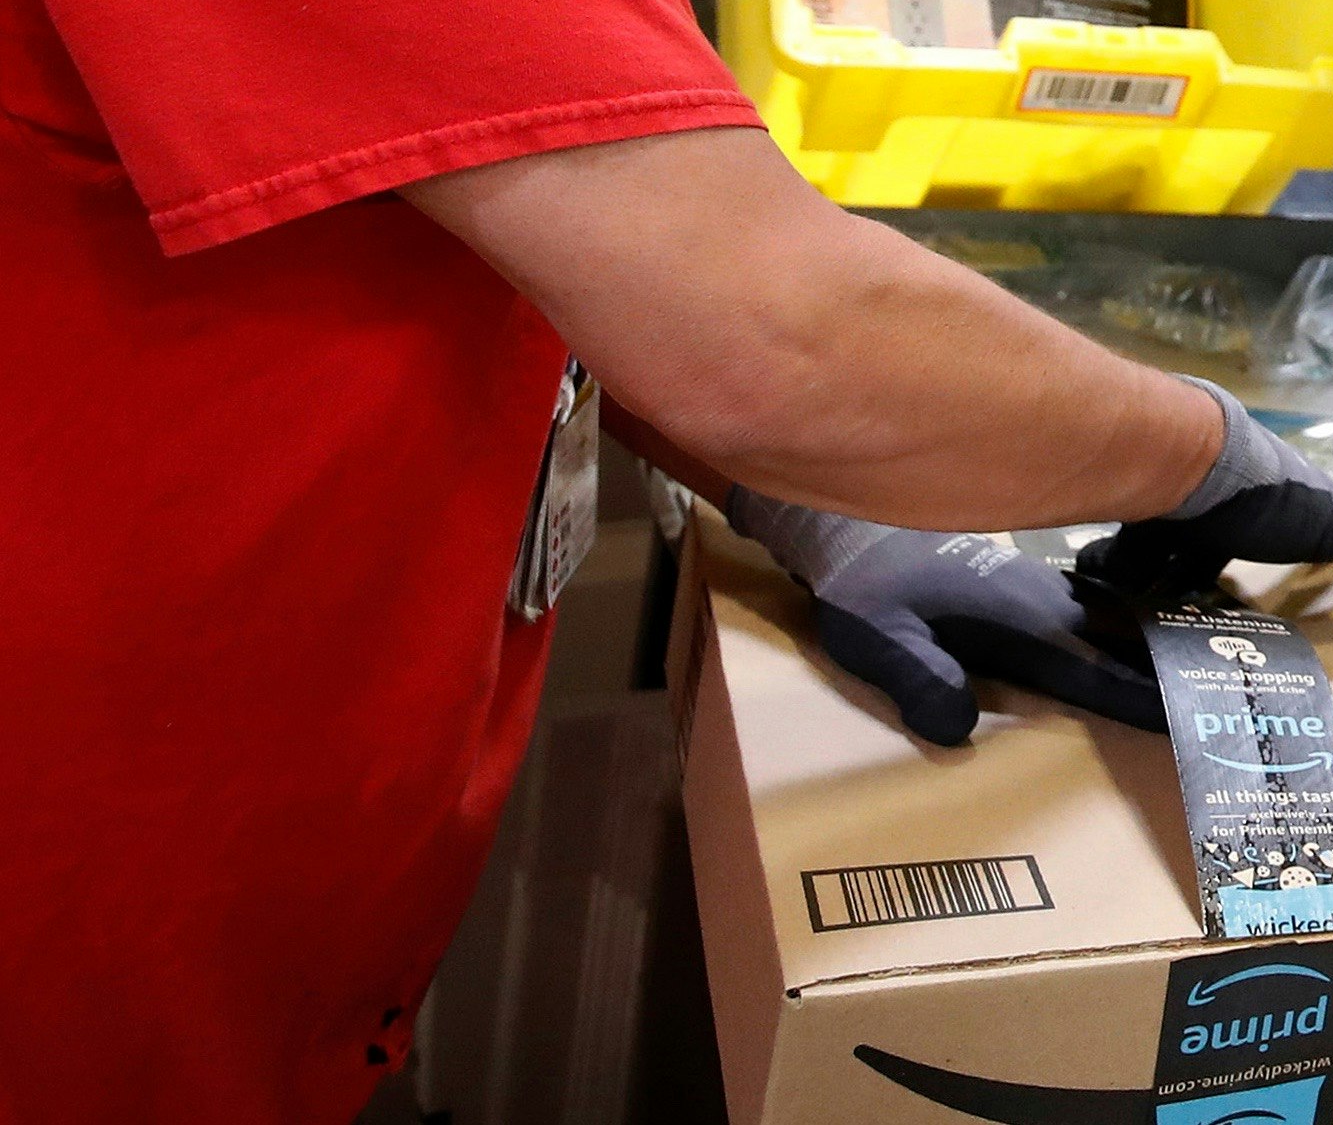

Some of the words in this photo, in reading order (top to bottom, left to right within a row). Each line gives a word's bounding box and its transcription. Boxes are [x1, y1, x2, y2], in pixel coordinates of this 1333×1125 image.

[1178, 668, 1227, 682] voice
[1230, 669, 1316, 687] shopping
[1193, 705, 1327, 743] prime
[1205, 790, 1231, 805] all
[1235, 789, 1299, 806] things
[1210, 824, 1238, 838] for
[1239, 823, 1287, 837] Prime
[1179, 994, 1329, 1055] prime
[1158, 1056, 1332, 1096] wickedlyprime.com
